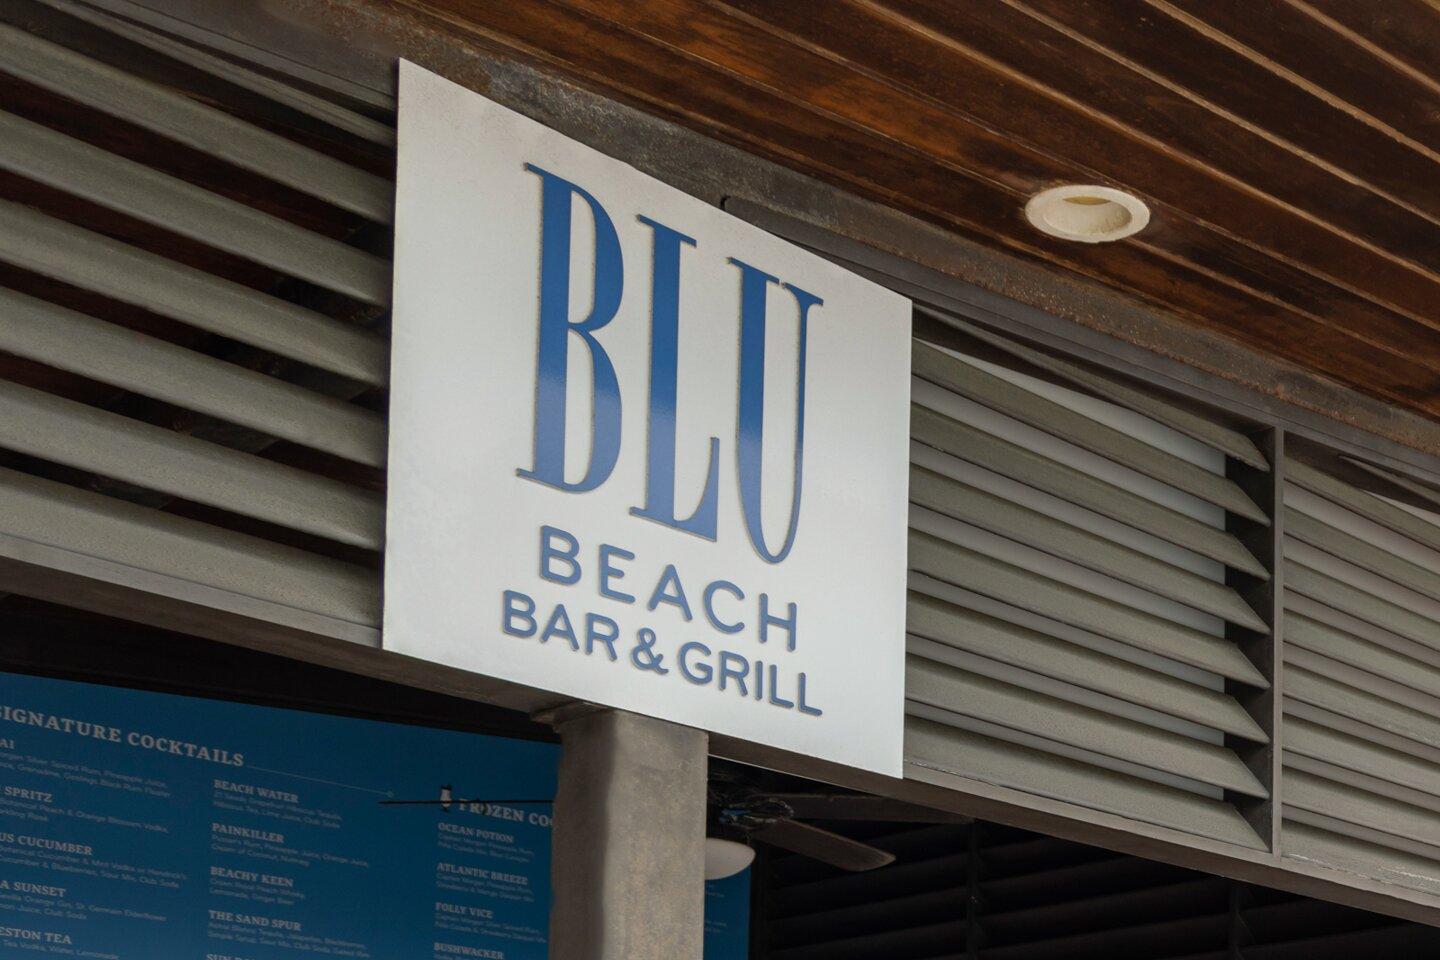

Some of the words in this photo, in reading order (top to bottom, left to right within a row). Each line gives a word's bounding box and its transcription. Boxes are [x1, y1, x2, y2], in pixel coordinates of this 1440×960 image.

[516, 162, 824, 564] BLU
[538, 524, 799, 652] BEACH
[501, 589, 824, 718] BAR&GRILL
[127, 731, 245, 767] COCKTAILS
[4, 785, 53, 804] SPRITZ
[213, 778, 254, 795] BEACH
[256, 786, 299, 804] WATER
[211, 822, 285, 844] PAINKILLER
[437, 822, 475, 837] OCEAN
[476, 829, 514, 844] POTION
[18, 834, 93, 856] CUCUMBER
[209, 865, 258, 883] BEACHY
[261, 874, 295, 888] KEEN
[436, 862, 489, 879] ATLANTIC
[490, 871, 528, 886] BREEZE
[14, 881, 66, 898] SUNSET
[208, 909, 233, 922] THE
[235, 913, 269, 928] SAND
[271, 918, 302, 932] SPUR
[435, 902, 466, 914] FOLLY
[468, 907, 494, 919] VICE
[44, 932, 73, 945] TEA
[433, 942, 505, 960] BUSHWACKER
